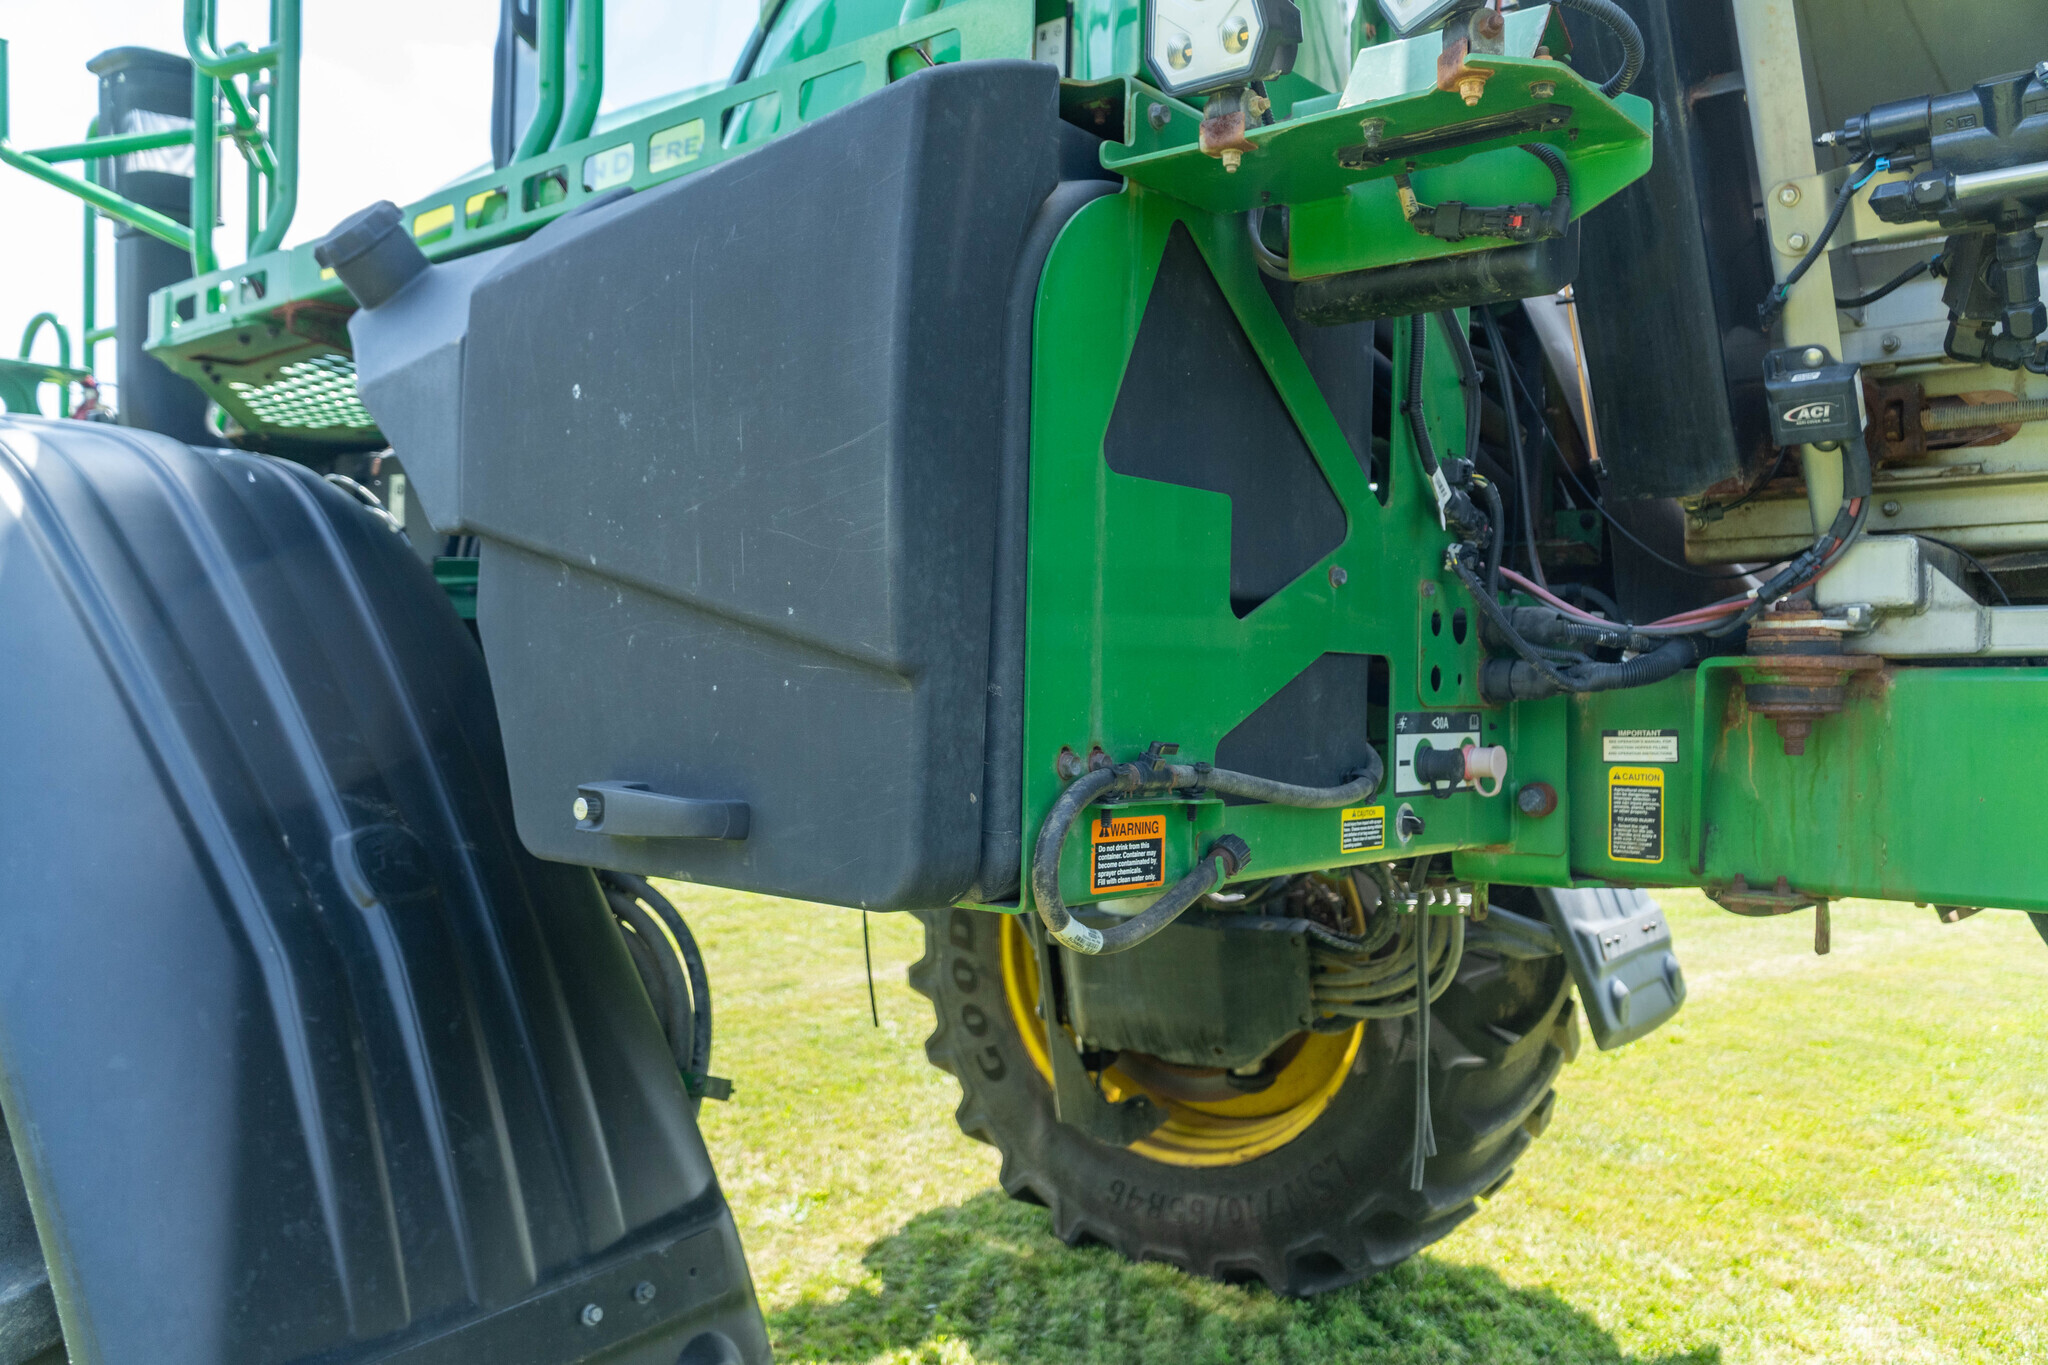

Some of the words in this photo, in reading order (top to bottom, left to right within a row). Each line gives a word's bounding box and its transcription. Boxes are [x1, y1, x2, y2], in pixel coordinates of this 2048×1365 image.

[1797, 405, 1830, 420] ACI
[1622, 773, 1660, 782] CAUTION
[1357, 809, 1375, 817] CAUTION
[1111, 821, 1159, 836] WARNING
[1116, 843, 1128, 851] drink
[1118, 858, 1150, 867] contaminated
[1098, 870, 1116, 878] sprayer
[1117, 867, 1142, 875] chemicals.
